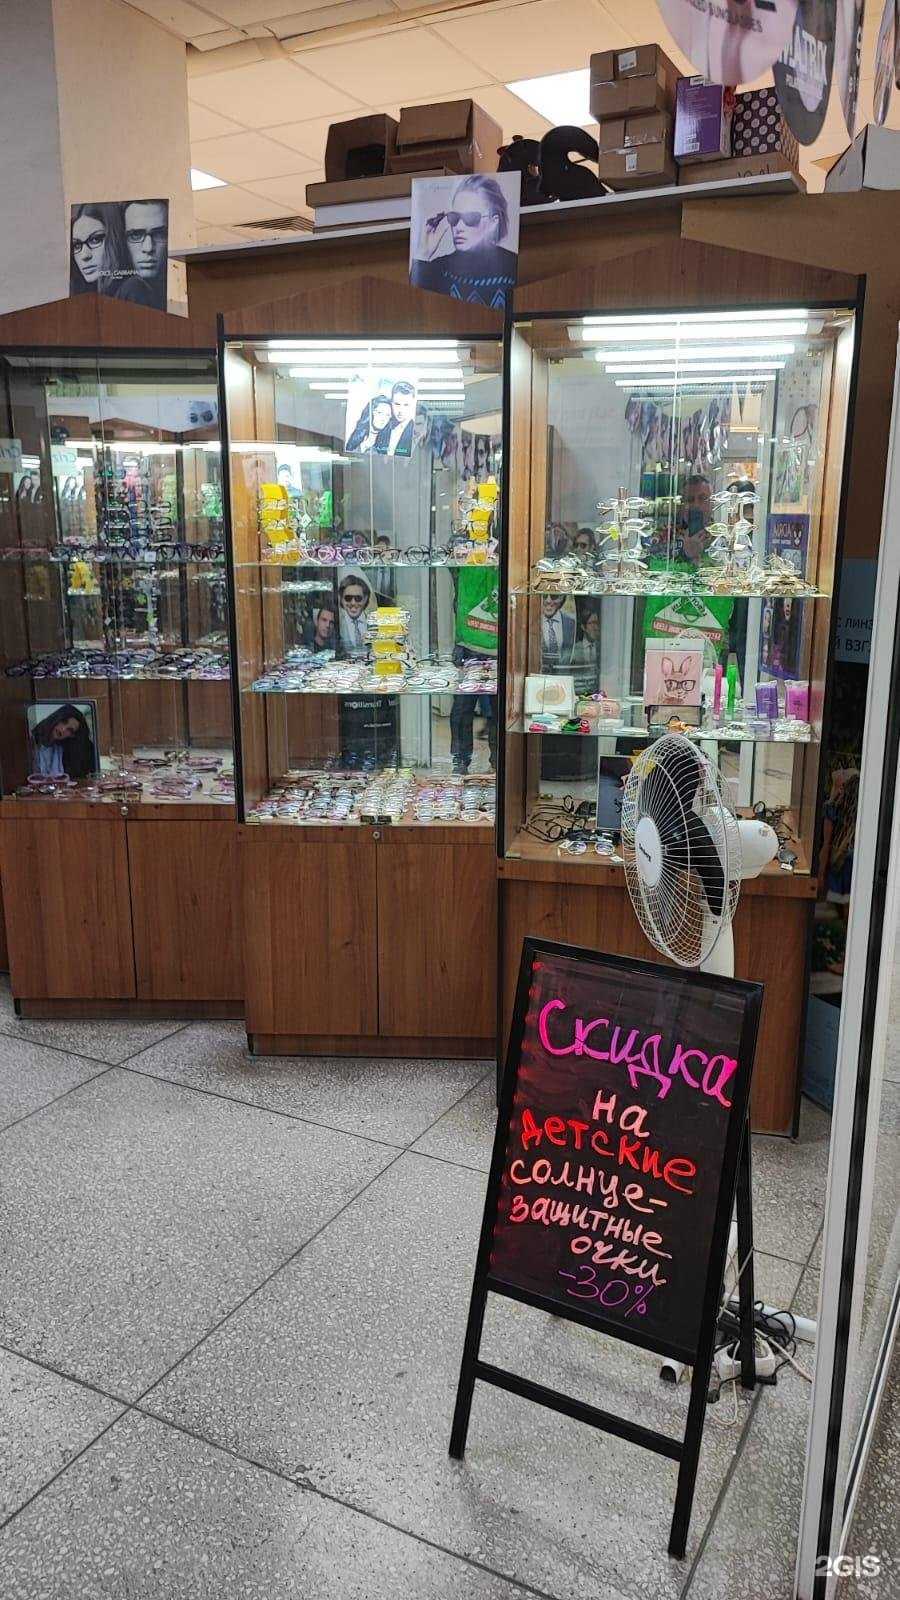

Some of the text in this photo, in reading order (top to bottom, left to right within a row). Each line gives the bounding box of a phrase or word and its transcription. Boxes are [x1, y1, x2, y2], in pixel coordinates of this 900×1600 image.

[845, 639, 872, 652] ВЗГ
[538, 998, 738, 1108] Скидка
[592, 1089, 651, 1138] на
[521, 1108, 697, 1195] детские
[509, 1158, 668, 1214] солнце-
[509, 1195, 673, 1260] защитные
[570, 1235, 668, 1287] очки
[558, 1265, 657, 1318] -30%
